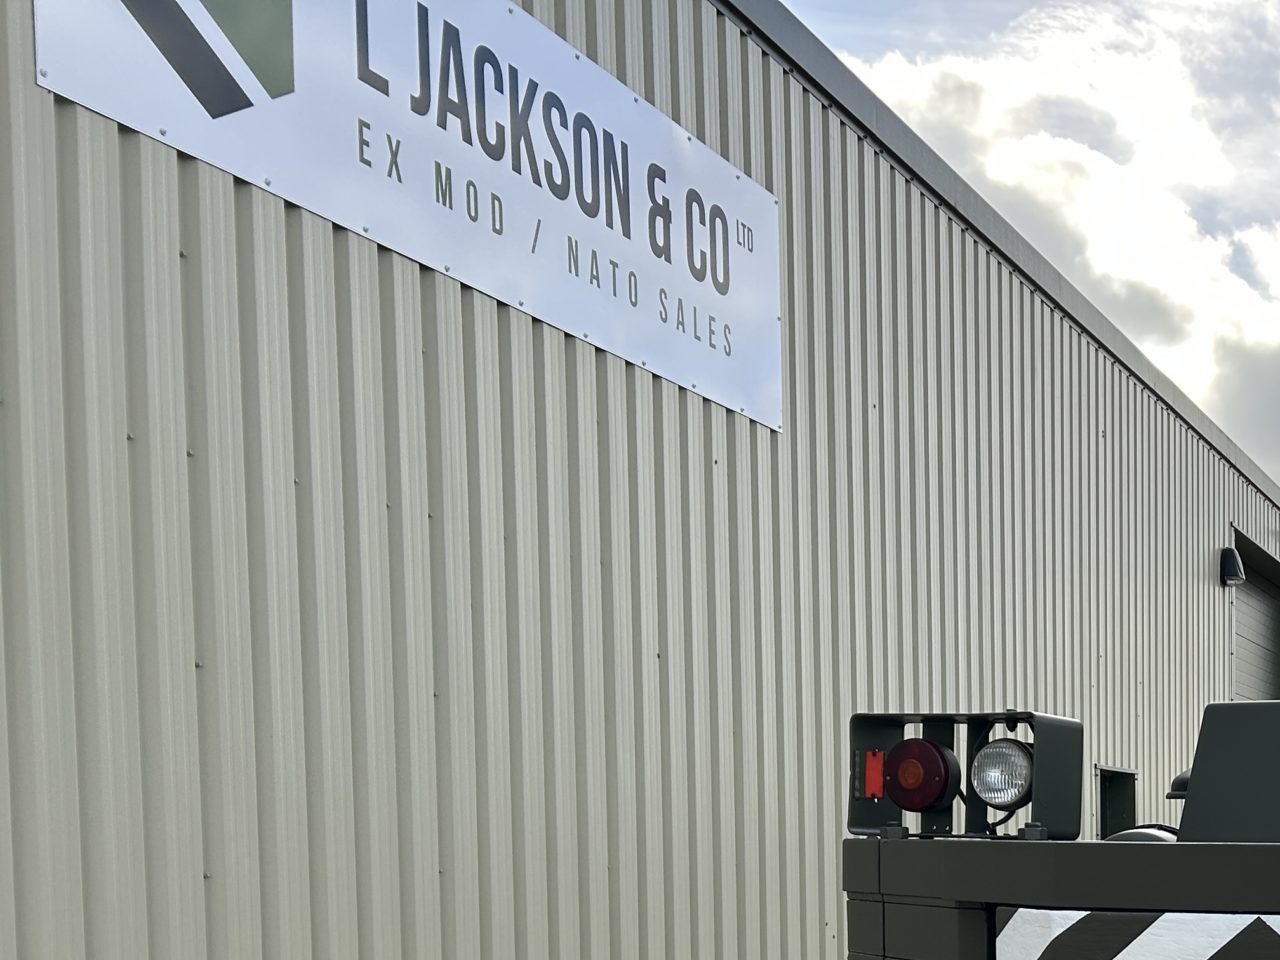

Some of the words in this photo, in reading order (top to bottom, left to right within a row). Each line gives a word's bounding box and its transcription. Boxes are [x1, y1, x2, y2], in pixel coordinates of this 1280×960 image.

[355, 0, 390, 97] L
[409, 0, 632, 240] JACKSON
[646, 163, 673, 265] &
[685, 187, 730, 296] CO
[736, 218, 754, 253] LTD
[357, 118, 402, 184] EX
[434, 160, 504, 236] MOD
[531, 218, 542, 255] /
[567, 235, 638, 308] NATO
[658, 287, 732, 357] SALES
